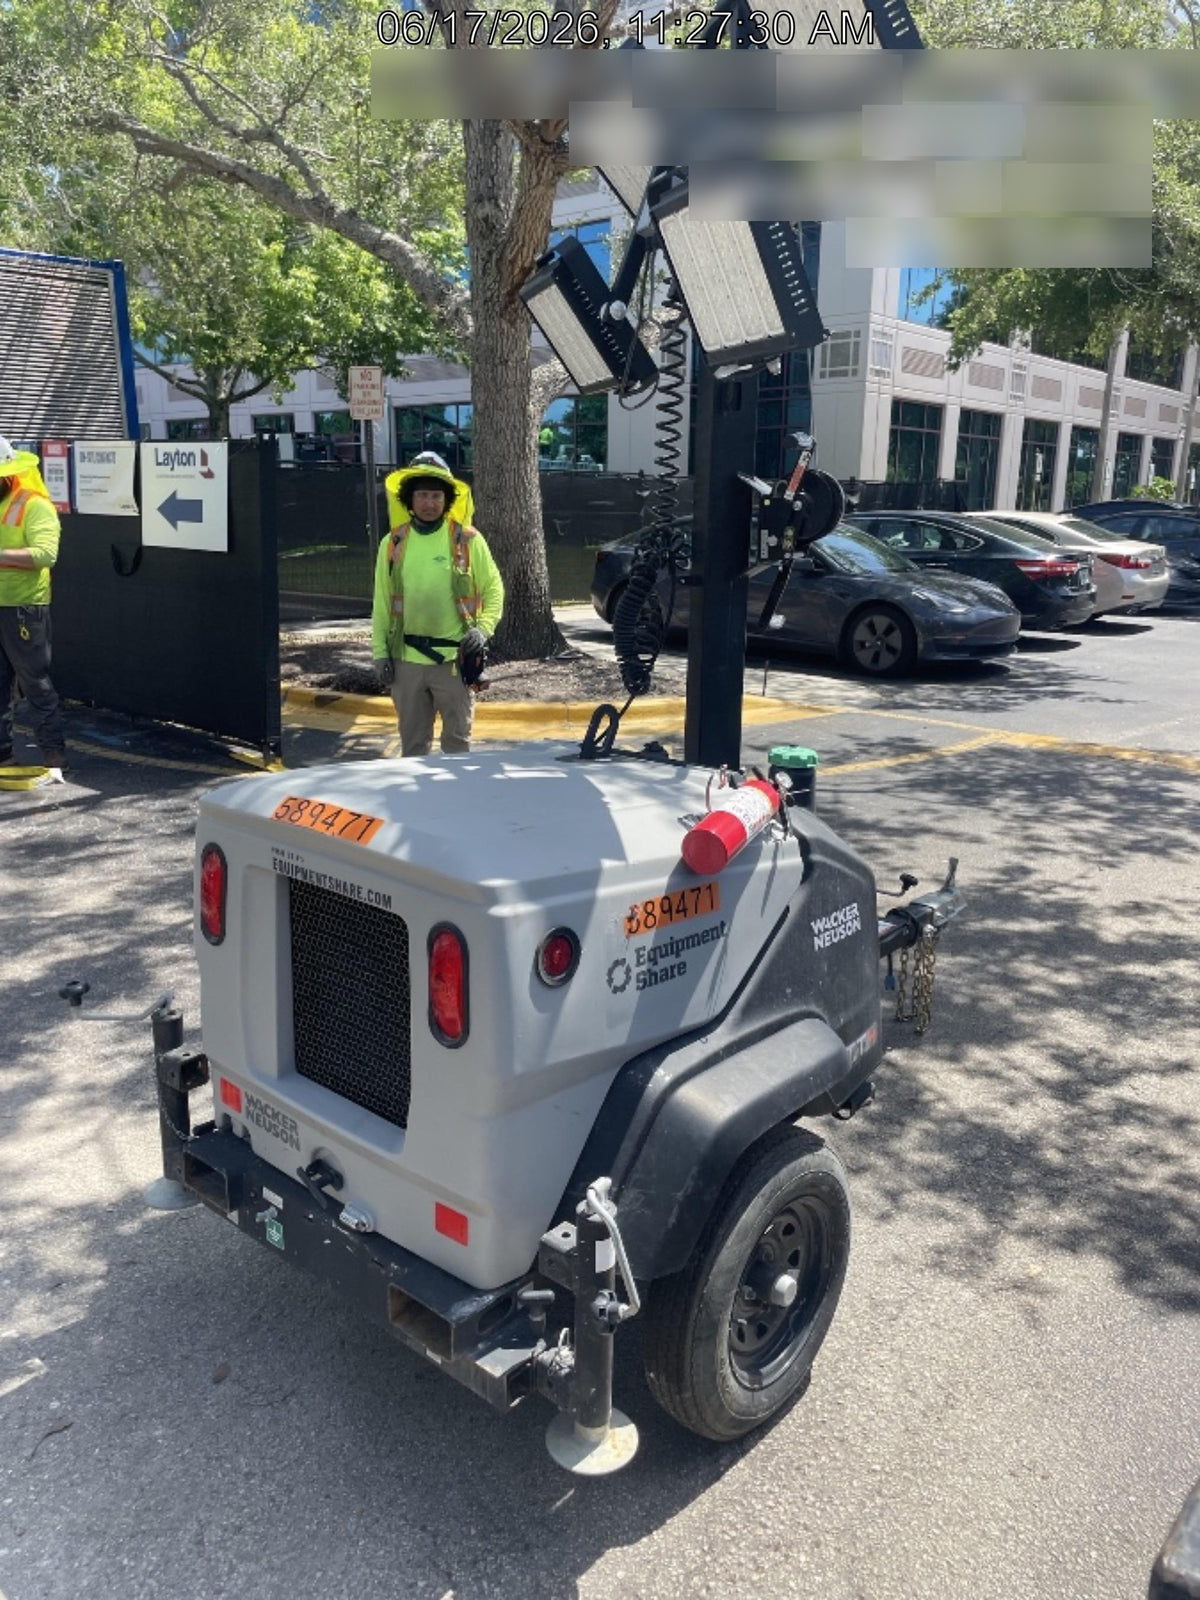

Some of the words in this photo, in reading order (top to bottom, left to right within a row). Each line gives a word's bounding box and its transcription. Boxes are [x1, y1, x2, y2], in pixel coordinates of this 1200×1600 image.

[154, 447, 196, 471] Layton
[275, 797, 376, 841] 589471
[272, 857, 392, 910] EQUIPMENTSHARE.COM
[626, 883, 714, 934] 589471
[811, 902, 860, 935] WACKER
[634, 920, 727, 968] Equipment
[813, 917, 861, 952] NEUSON
[635, 961, 687, 991] Share
[244, 1091, 299, 1137] WACKER
[246, 1103, 301, 1152] NEUSON
